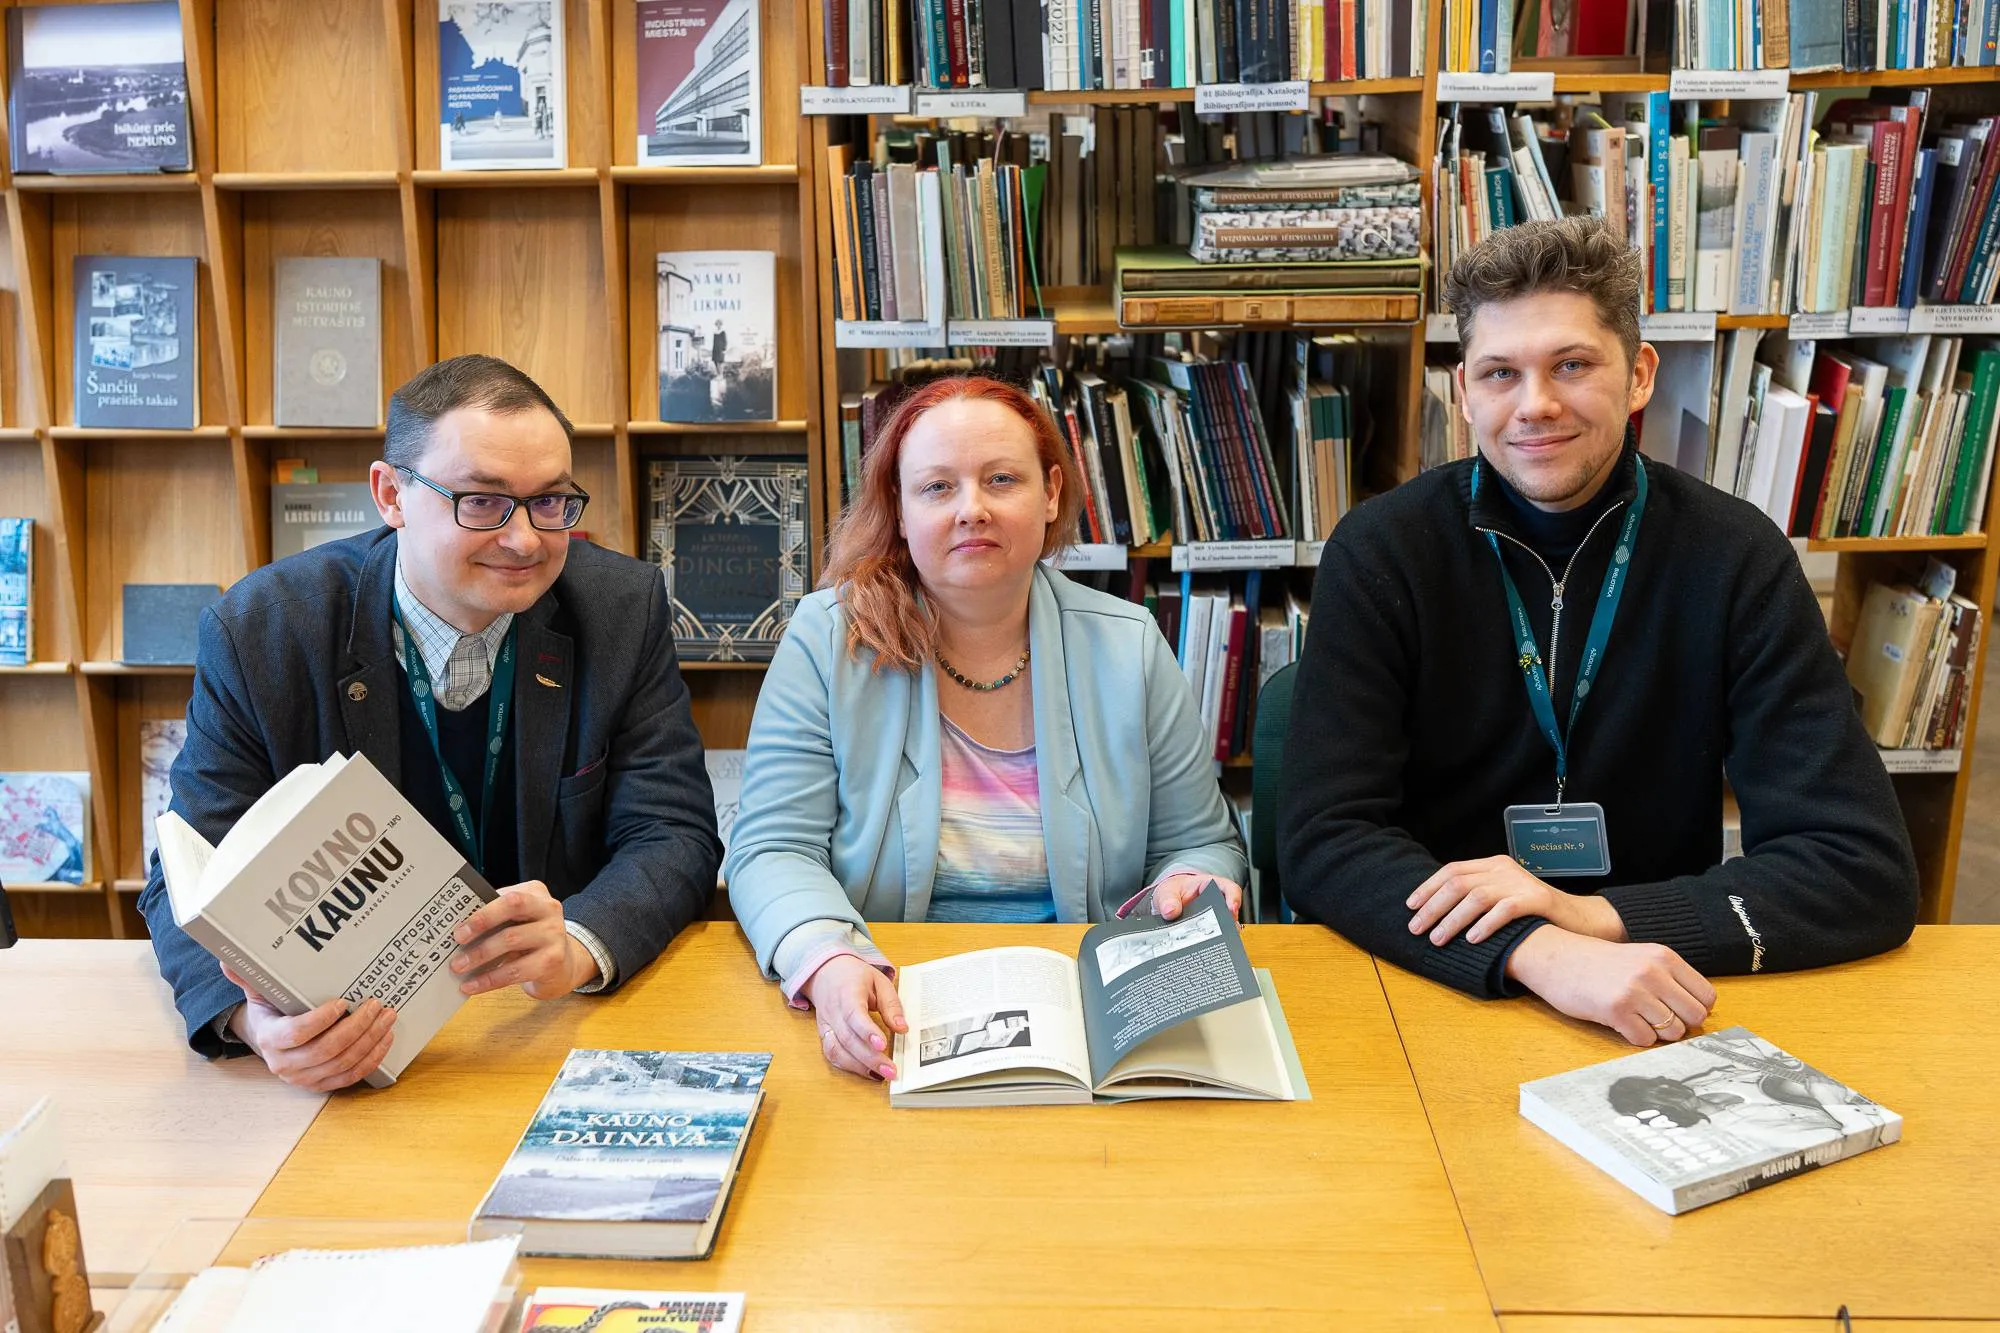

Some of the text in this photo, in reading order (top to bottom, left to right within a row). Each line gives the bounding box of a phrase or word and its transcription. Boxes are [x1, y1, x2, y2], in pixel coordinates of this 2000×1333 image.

[644, 18, 706, 29] INDUSTRINIS
[644, 28, 687, 38] MIESTAS
[153, 121, 176, 135] prie
[127, 135, 177, 147] NEMUNO
[1655, 128, 1668, 227] katalogas
[692, 273, 742, 284] NAMAI
[305, 286, 352, 299] KAUNO
[296, 301, 361, 315] ISTORIJOS
[693, 300, 742, 311] LIKIMAI
[292, 315, 366, 328] METRAŠTIS
[86, 371, 138, 397] Šančių
[97, 393, 178, 408] praeities takais
[333, 510, 365, 523] ALĖJA
[1606, 567, 1620, 598] BIBLIOTEKA
[386, 814, 402, 832] TAPO
[1530, 841, 1585, 851] Svečias Nr. 9
[264, 812, 377, 927] KOVNO
[294, 837, 405, 953] KAUNU
[353, 863, 416, 928] MINDAUGAS BALKUS
[419, 891, 476, 946] Witolda.
[271, 935, 285, 950] KAIP
[345, 952, 395, 1006] Vytauto
[393, 882, 465, 953] Prospektas.
[583, 1113, 693, 1128] KAUNO
[548, 1130, 708, 1147] DAINAVA
[1761, 1156, 1801, 1180] KAUNO
